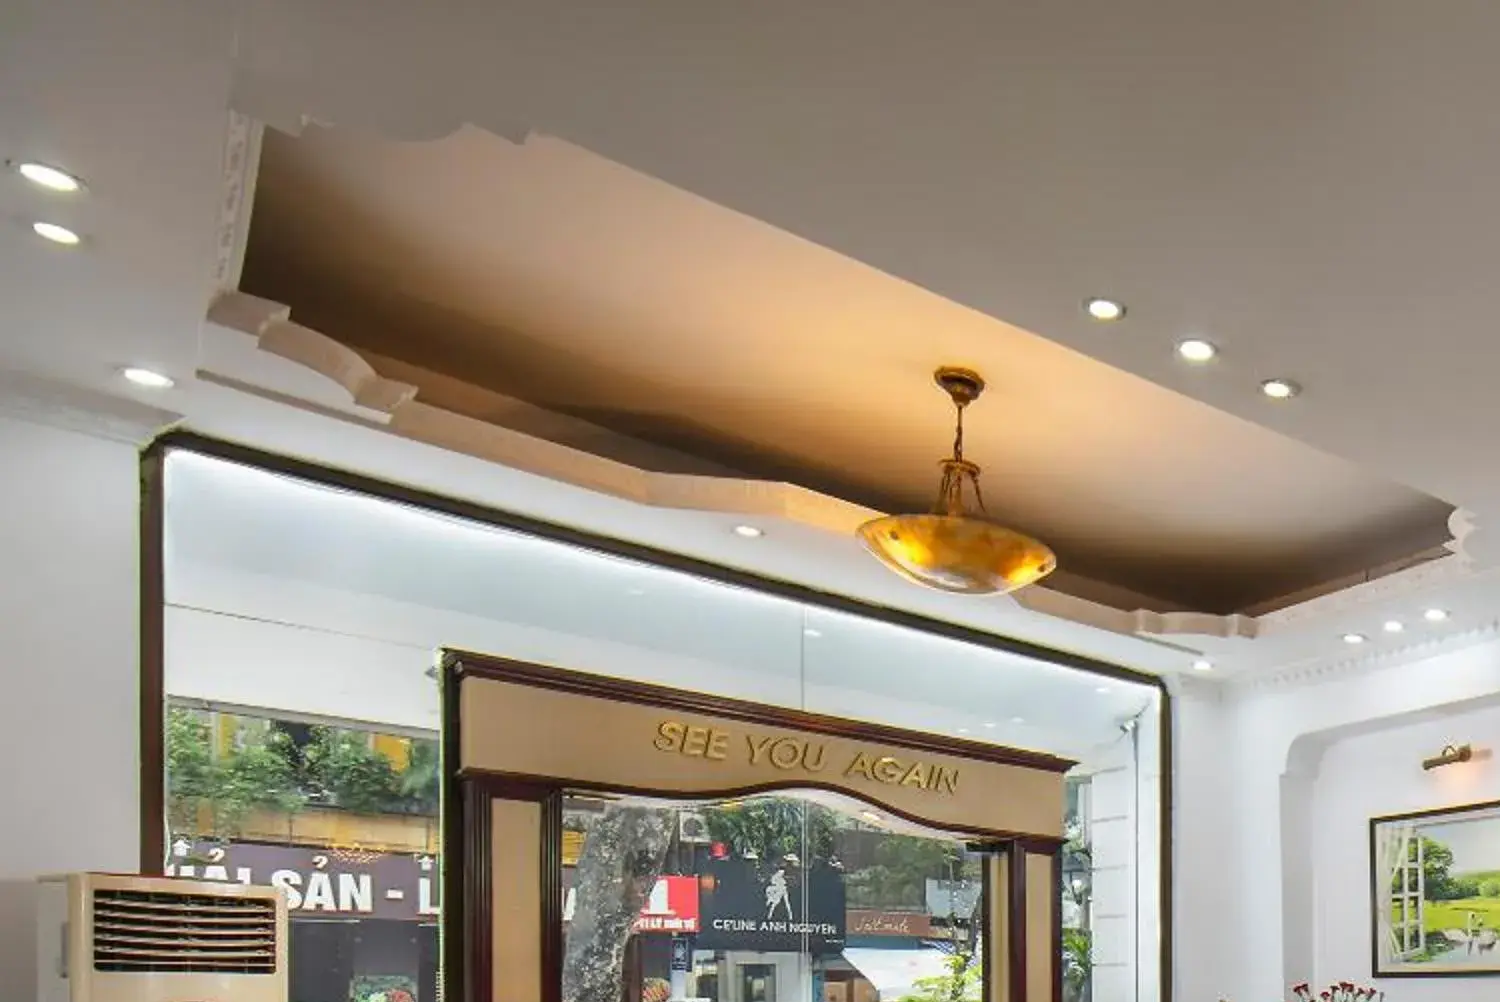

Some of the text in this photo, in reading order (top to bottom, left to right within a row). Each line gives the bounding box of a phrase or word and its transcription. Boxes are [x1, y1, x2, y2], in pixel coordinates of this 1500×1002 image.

[653, 719, 959, 795] SEE YOU AGAIN
[759, 920, 787, 933] ANH
